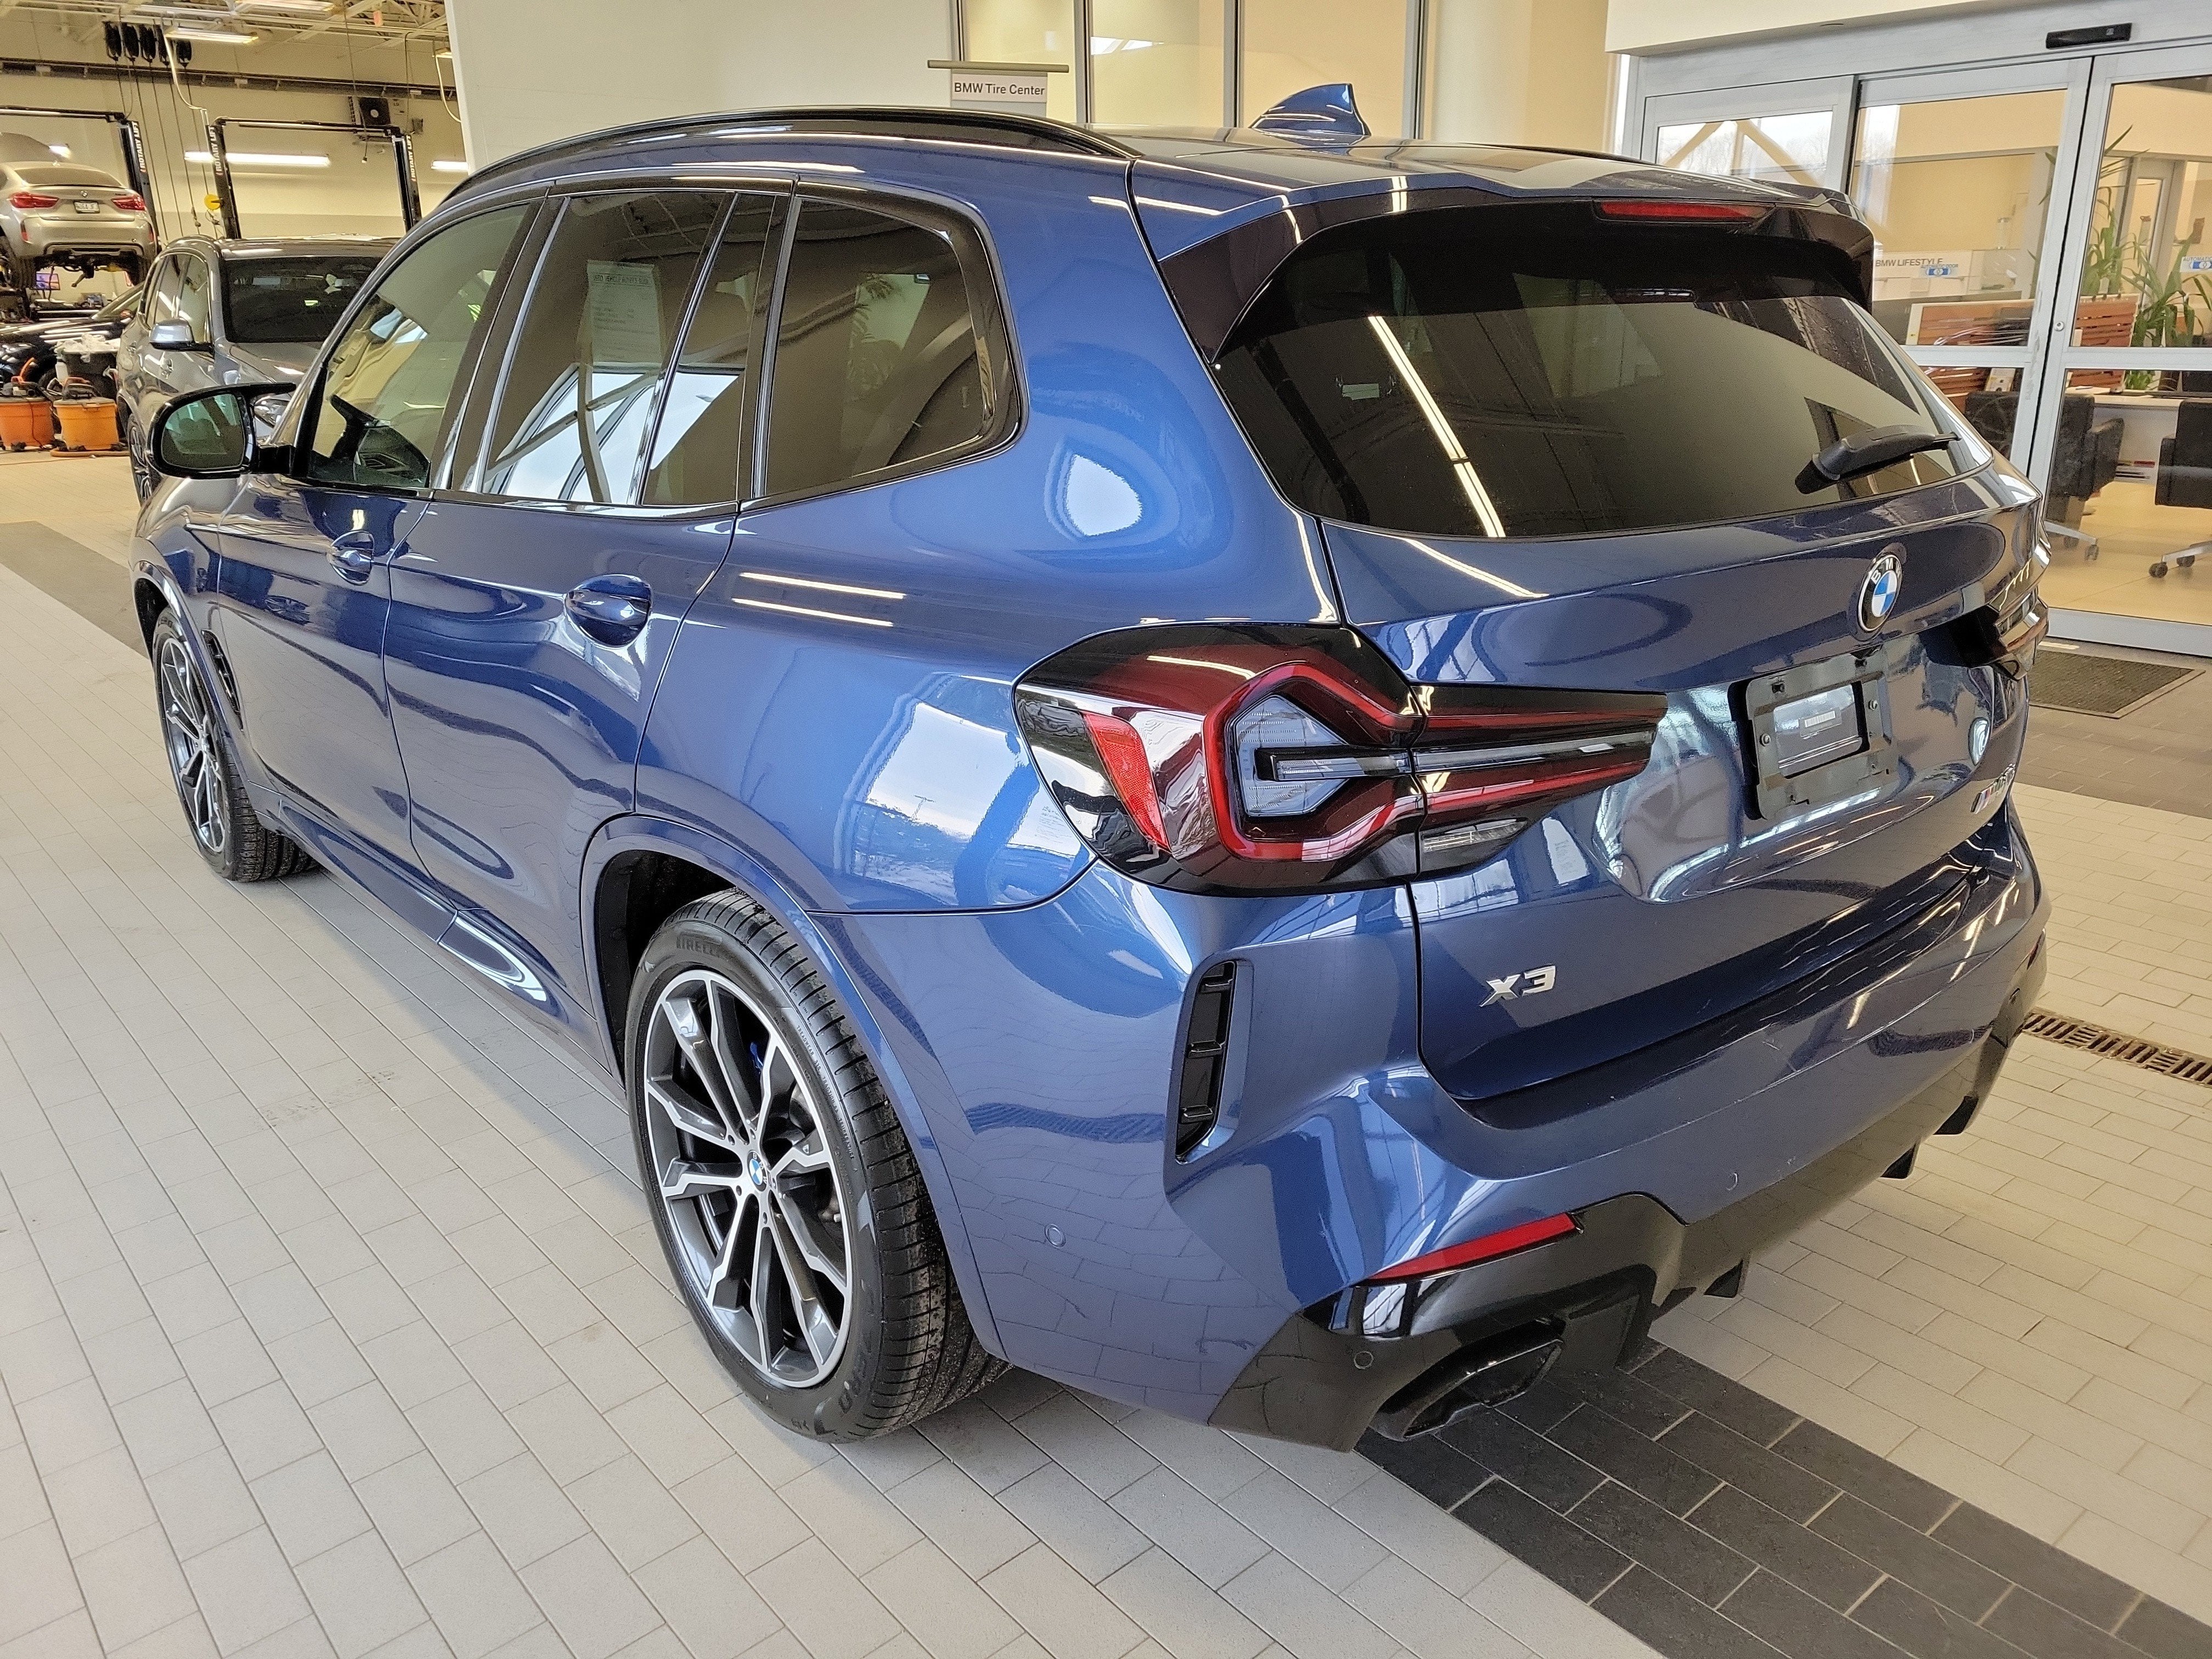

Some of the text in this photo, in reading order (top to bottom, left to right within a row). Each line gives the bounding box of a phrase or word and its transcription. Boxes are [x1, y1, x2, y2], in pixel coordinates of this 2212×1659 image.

[954, 82, 1045, 95] BMW Tire Center
[135, 138, 146, 168] ROTARY
[211, 142, 222, 172] ROTARY
[1898, 258, 1943, 267] LIFESTYLE
[1871, 557, 1901, 585] BMW
[1479, 963, 1556, 1007] X3
[797, 1025, 815, 1056] TREADWEAR
